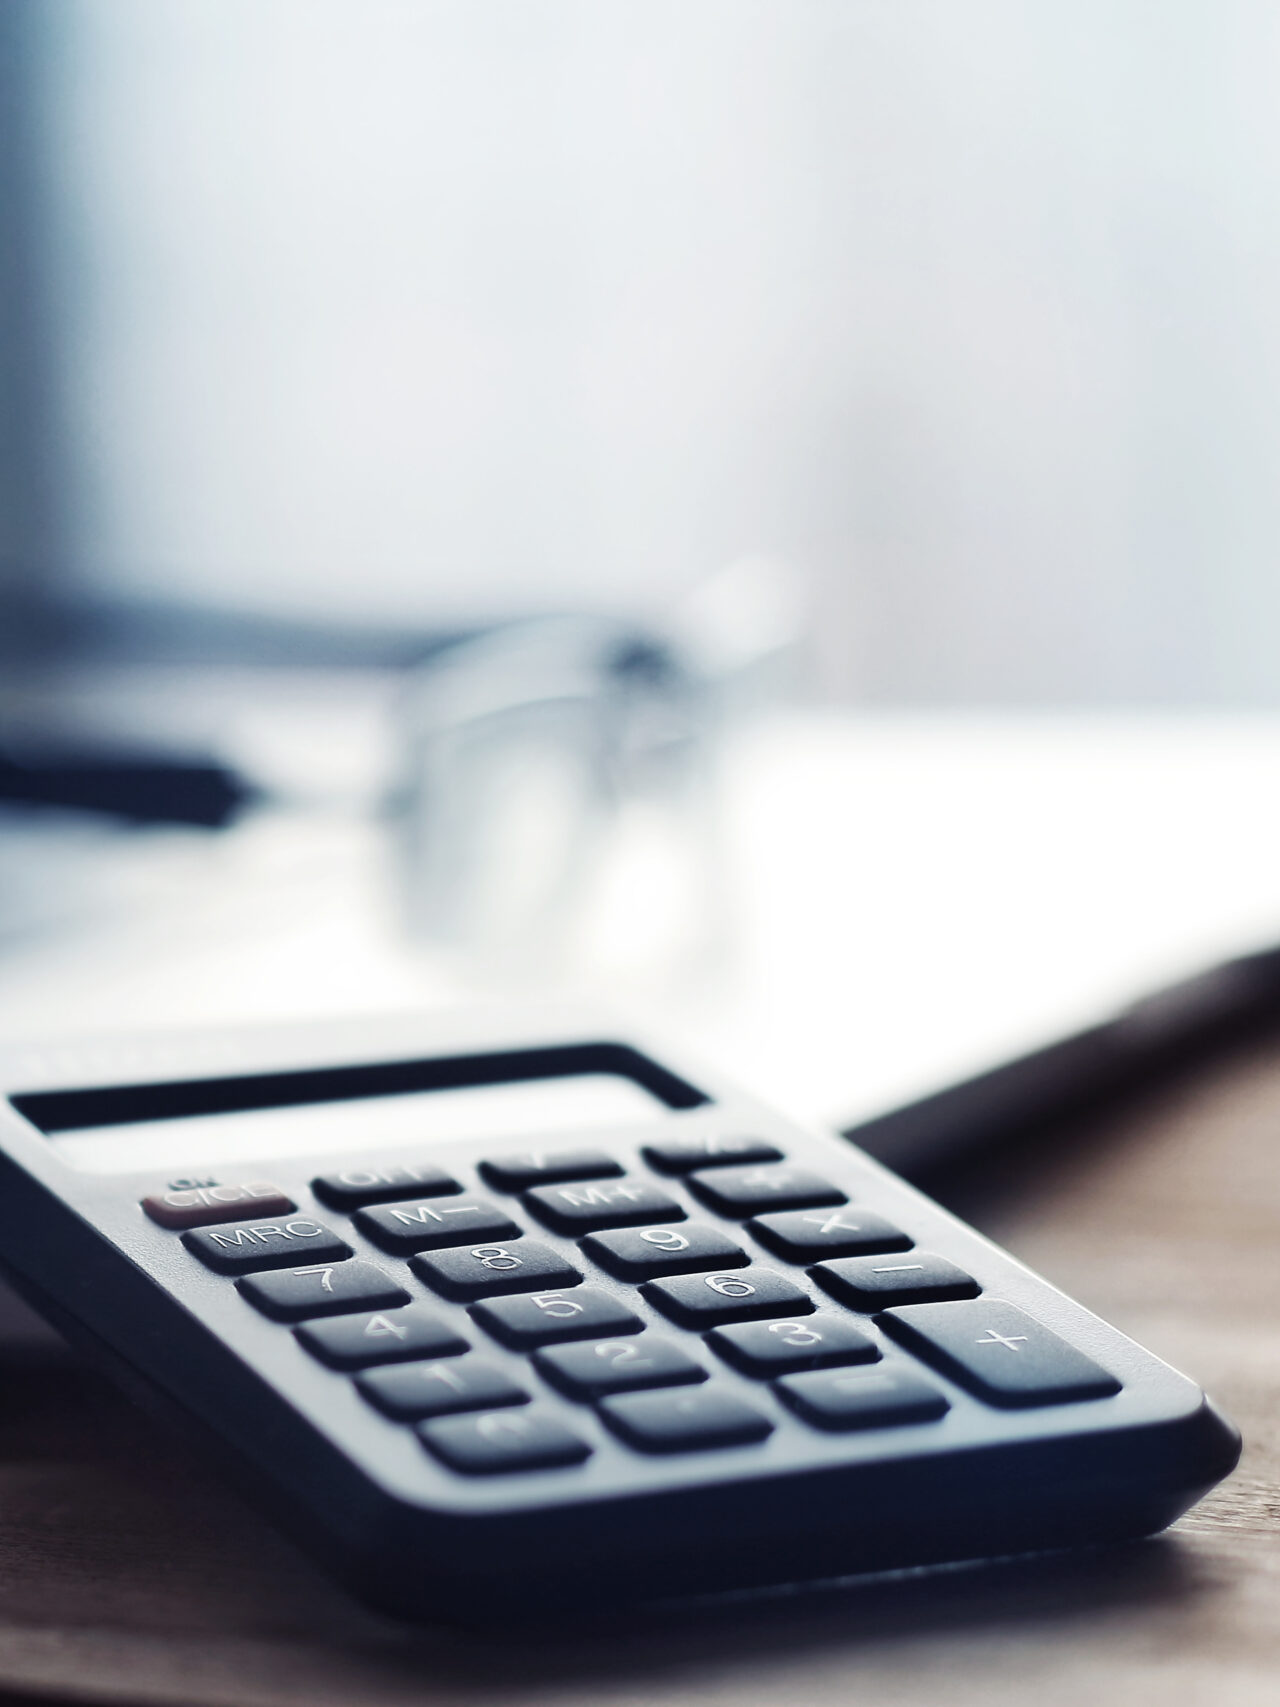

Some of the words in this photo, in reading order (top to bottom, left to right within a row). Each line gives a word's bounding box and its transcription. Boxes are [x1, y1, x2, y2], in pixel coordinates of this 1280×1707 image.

[209, 1222, 323, 1250] MRC
[639, 1228, 691, 1252] 9
[471, 1247, 524, 1271] 8
[293, 1268, 335, 1294] 7
[704, 1274, 756, 1299] 6
[530, 1293, 585, 1318] 5
[363, 1314, 409, 1342] 4
[768, 1322, 823, 1347] 3
[594, 1340, 654, 1370] 2
